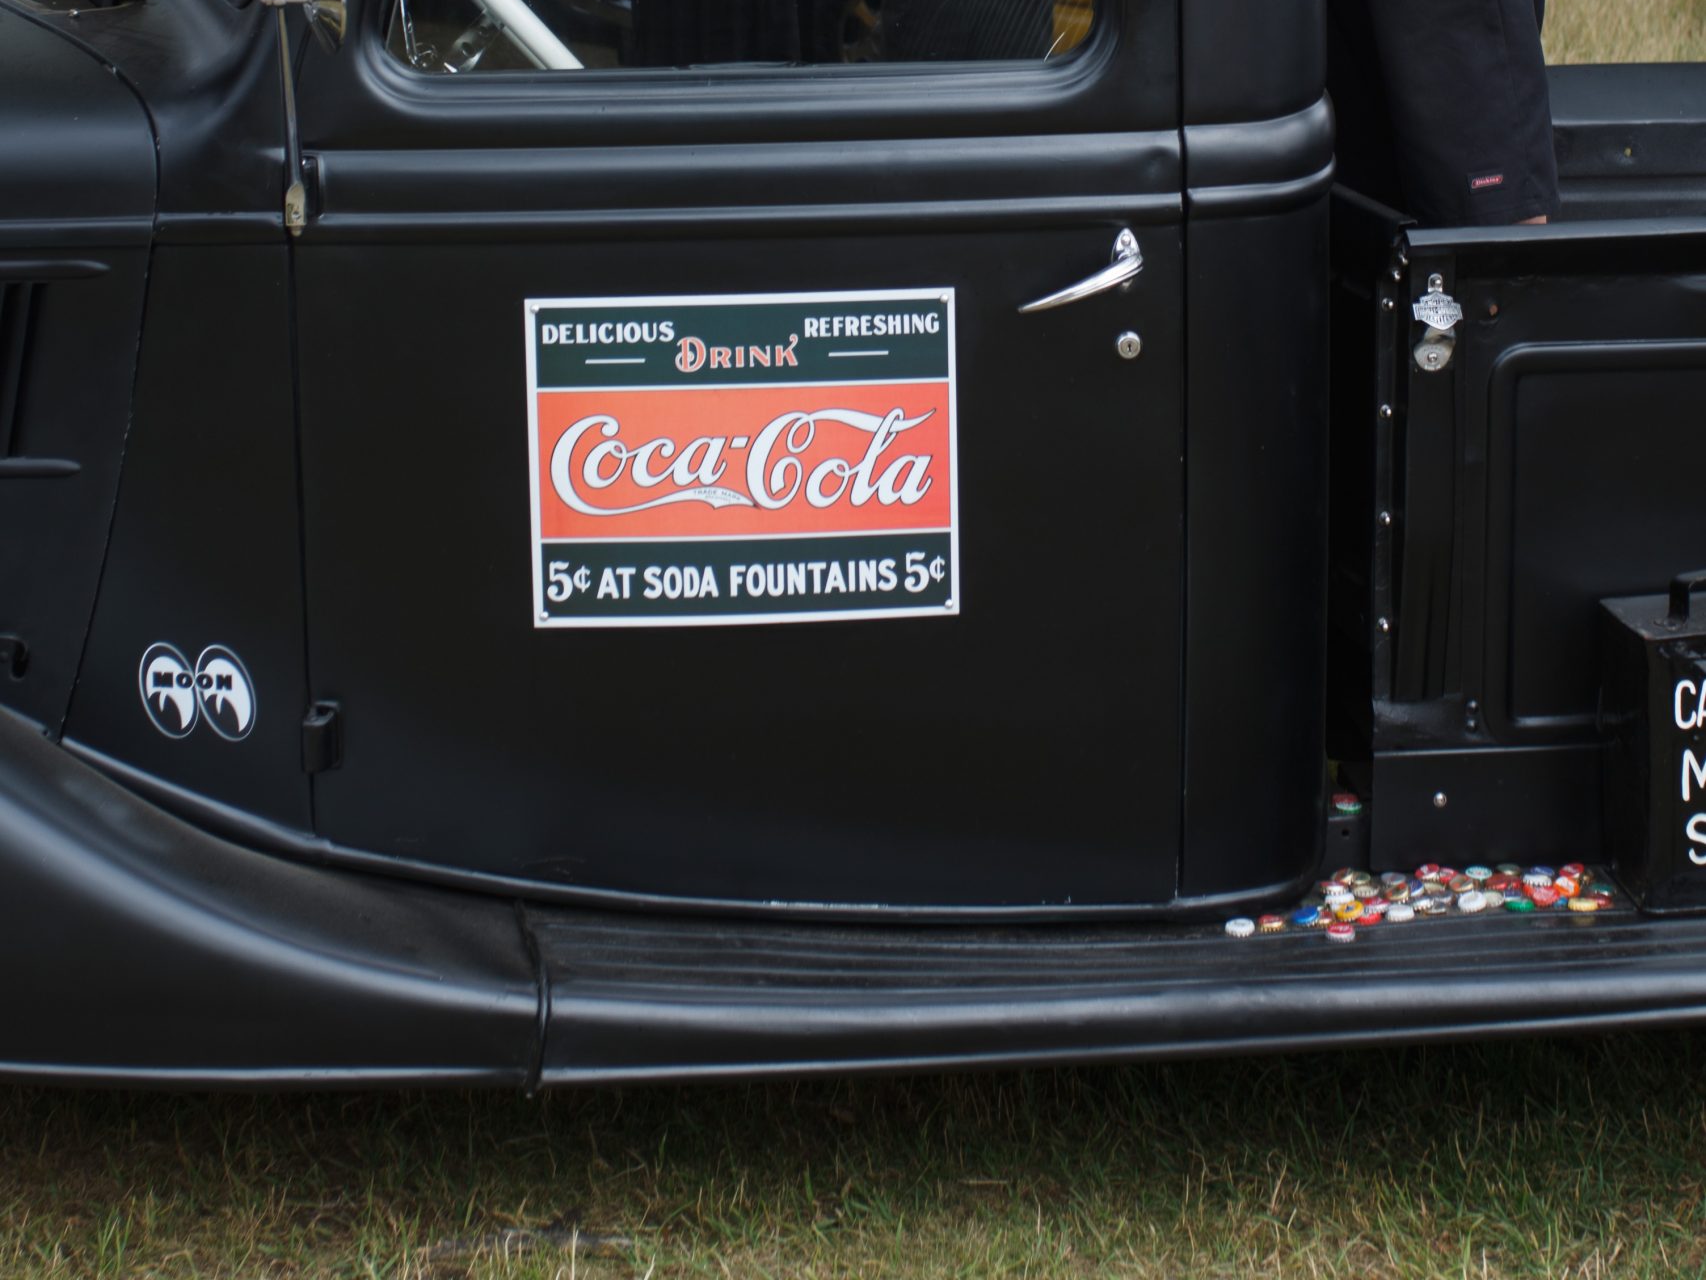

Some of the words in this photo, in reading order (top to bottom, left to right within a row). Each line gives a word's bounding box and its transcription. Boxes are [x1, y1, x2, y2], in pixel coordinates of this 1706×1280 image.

[541, 320, 675, 345] DELICIOUS
[804, 312, 940, 338] REFRESHING
[549, 407, 937, 517] Coca-Cola
[547, 559, 591, 602] 5¢
[597, 566, 636, 599] AT
[643, 565, 719, 599] SODA
[729, 558, 898, 598] FOUNTAINS
[904, 551, 946, 593] 5¢
[152, 671, 233, 691] MOON
